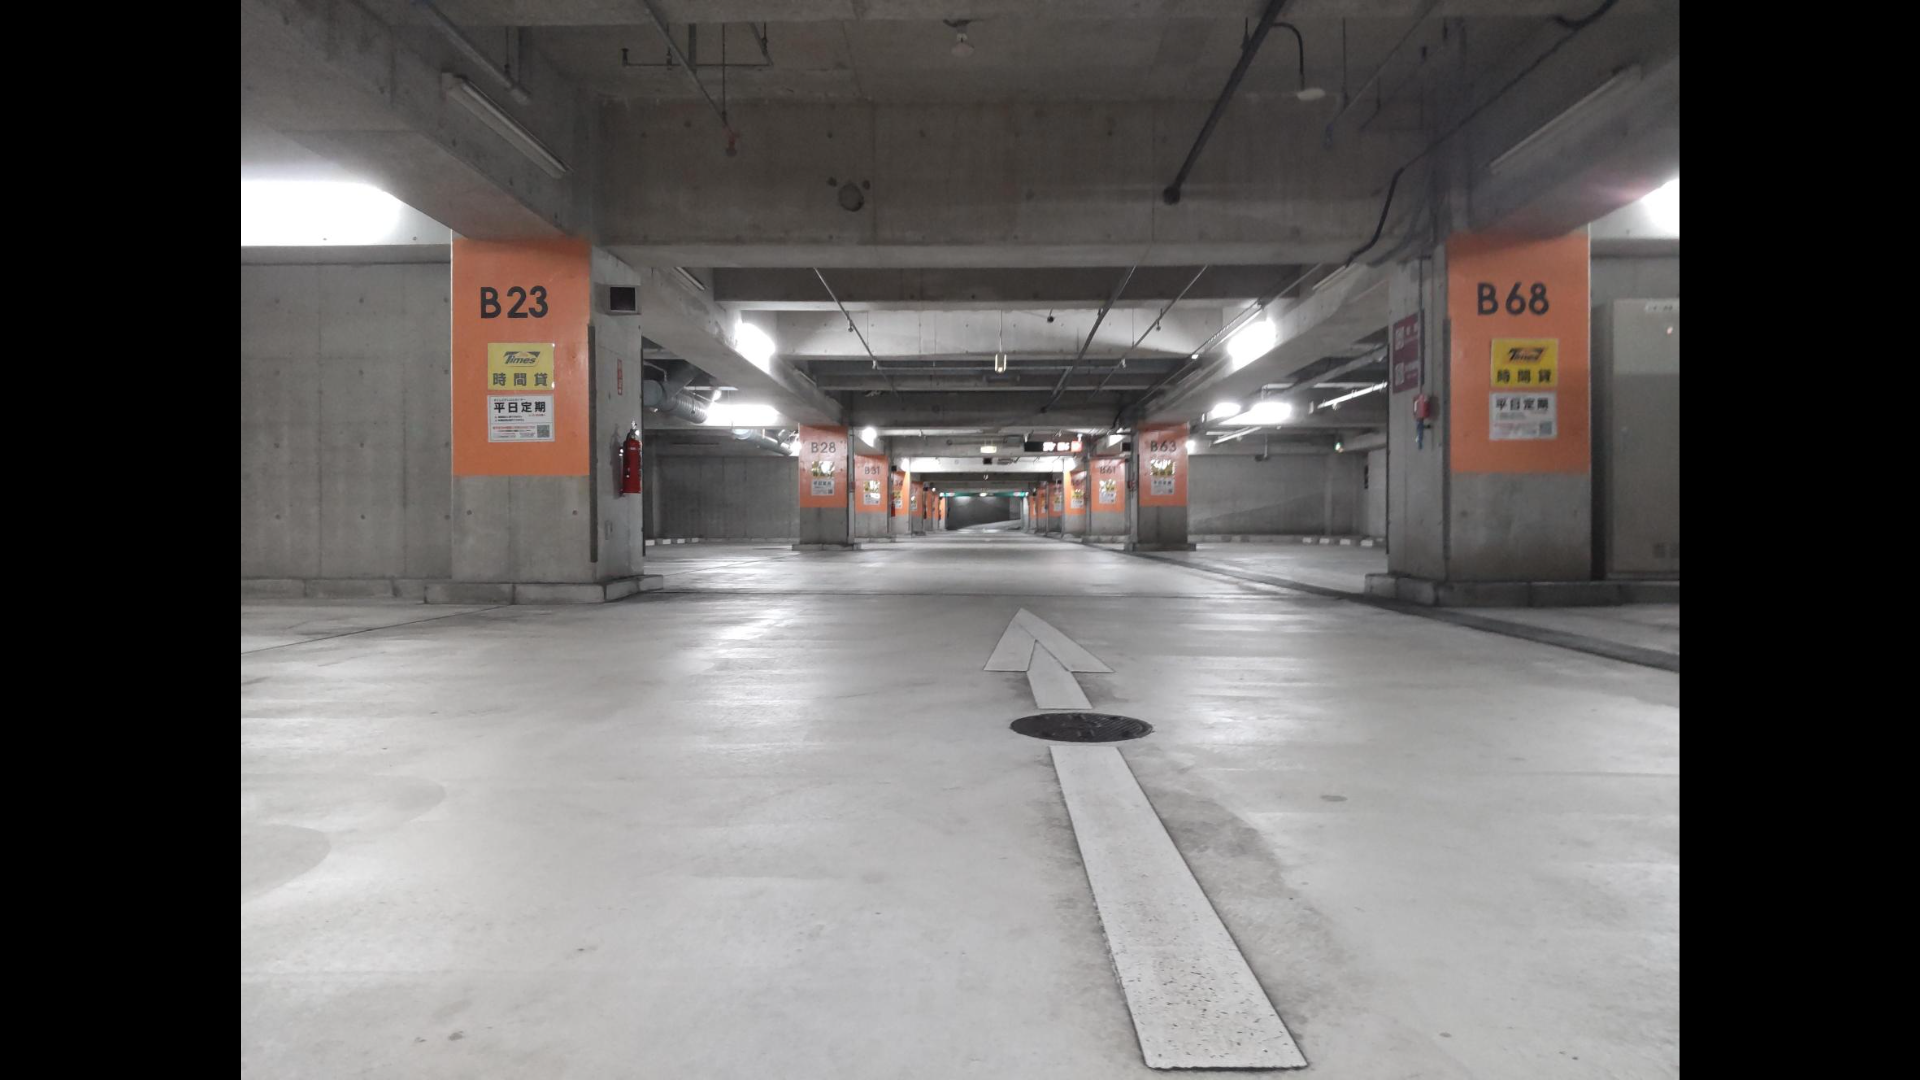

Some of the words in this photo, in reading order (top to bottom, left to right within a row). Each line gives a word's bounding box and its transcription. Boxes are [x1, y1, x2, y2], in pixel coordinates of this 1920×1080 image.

[503, 351, 541, 366] Times
[492, 373, 548, 387] 時間貸
[494, 401, 546, 413] 平日定期
[811, 441, 836, 454] B28
[1150, 440, 1177, 452] B63
